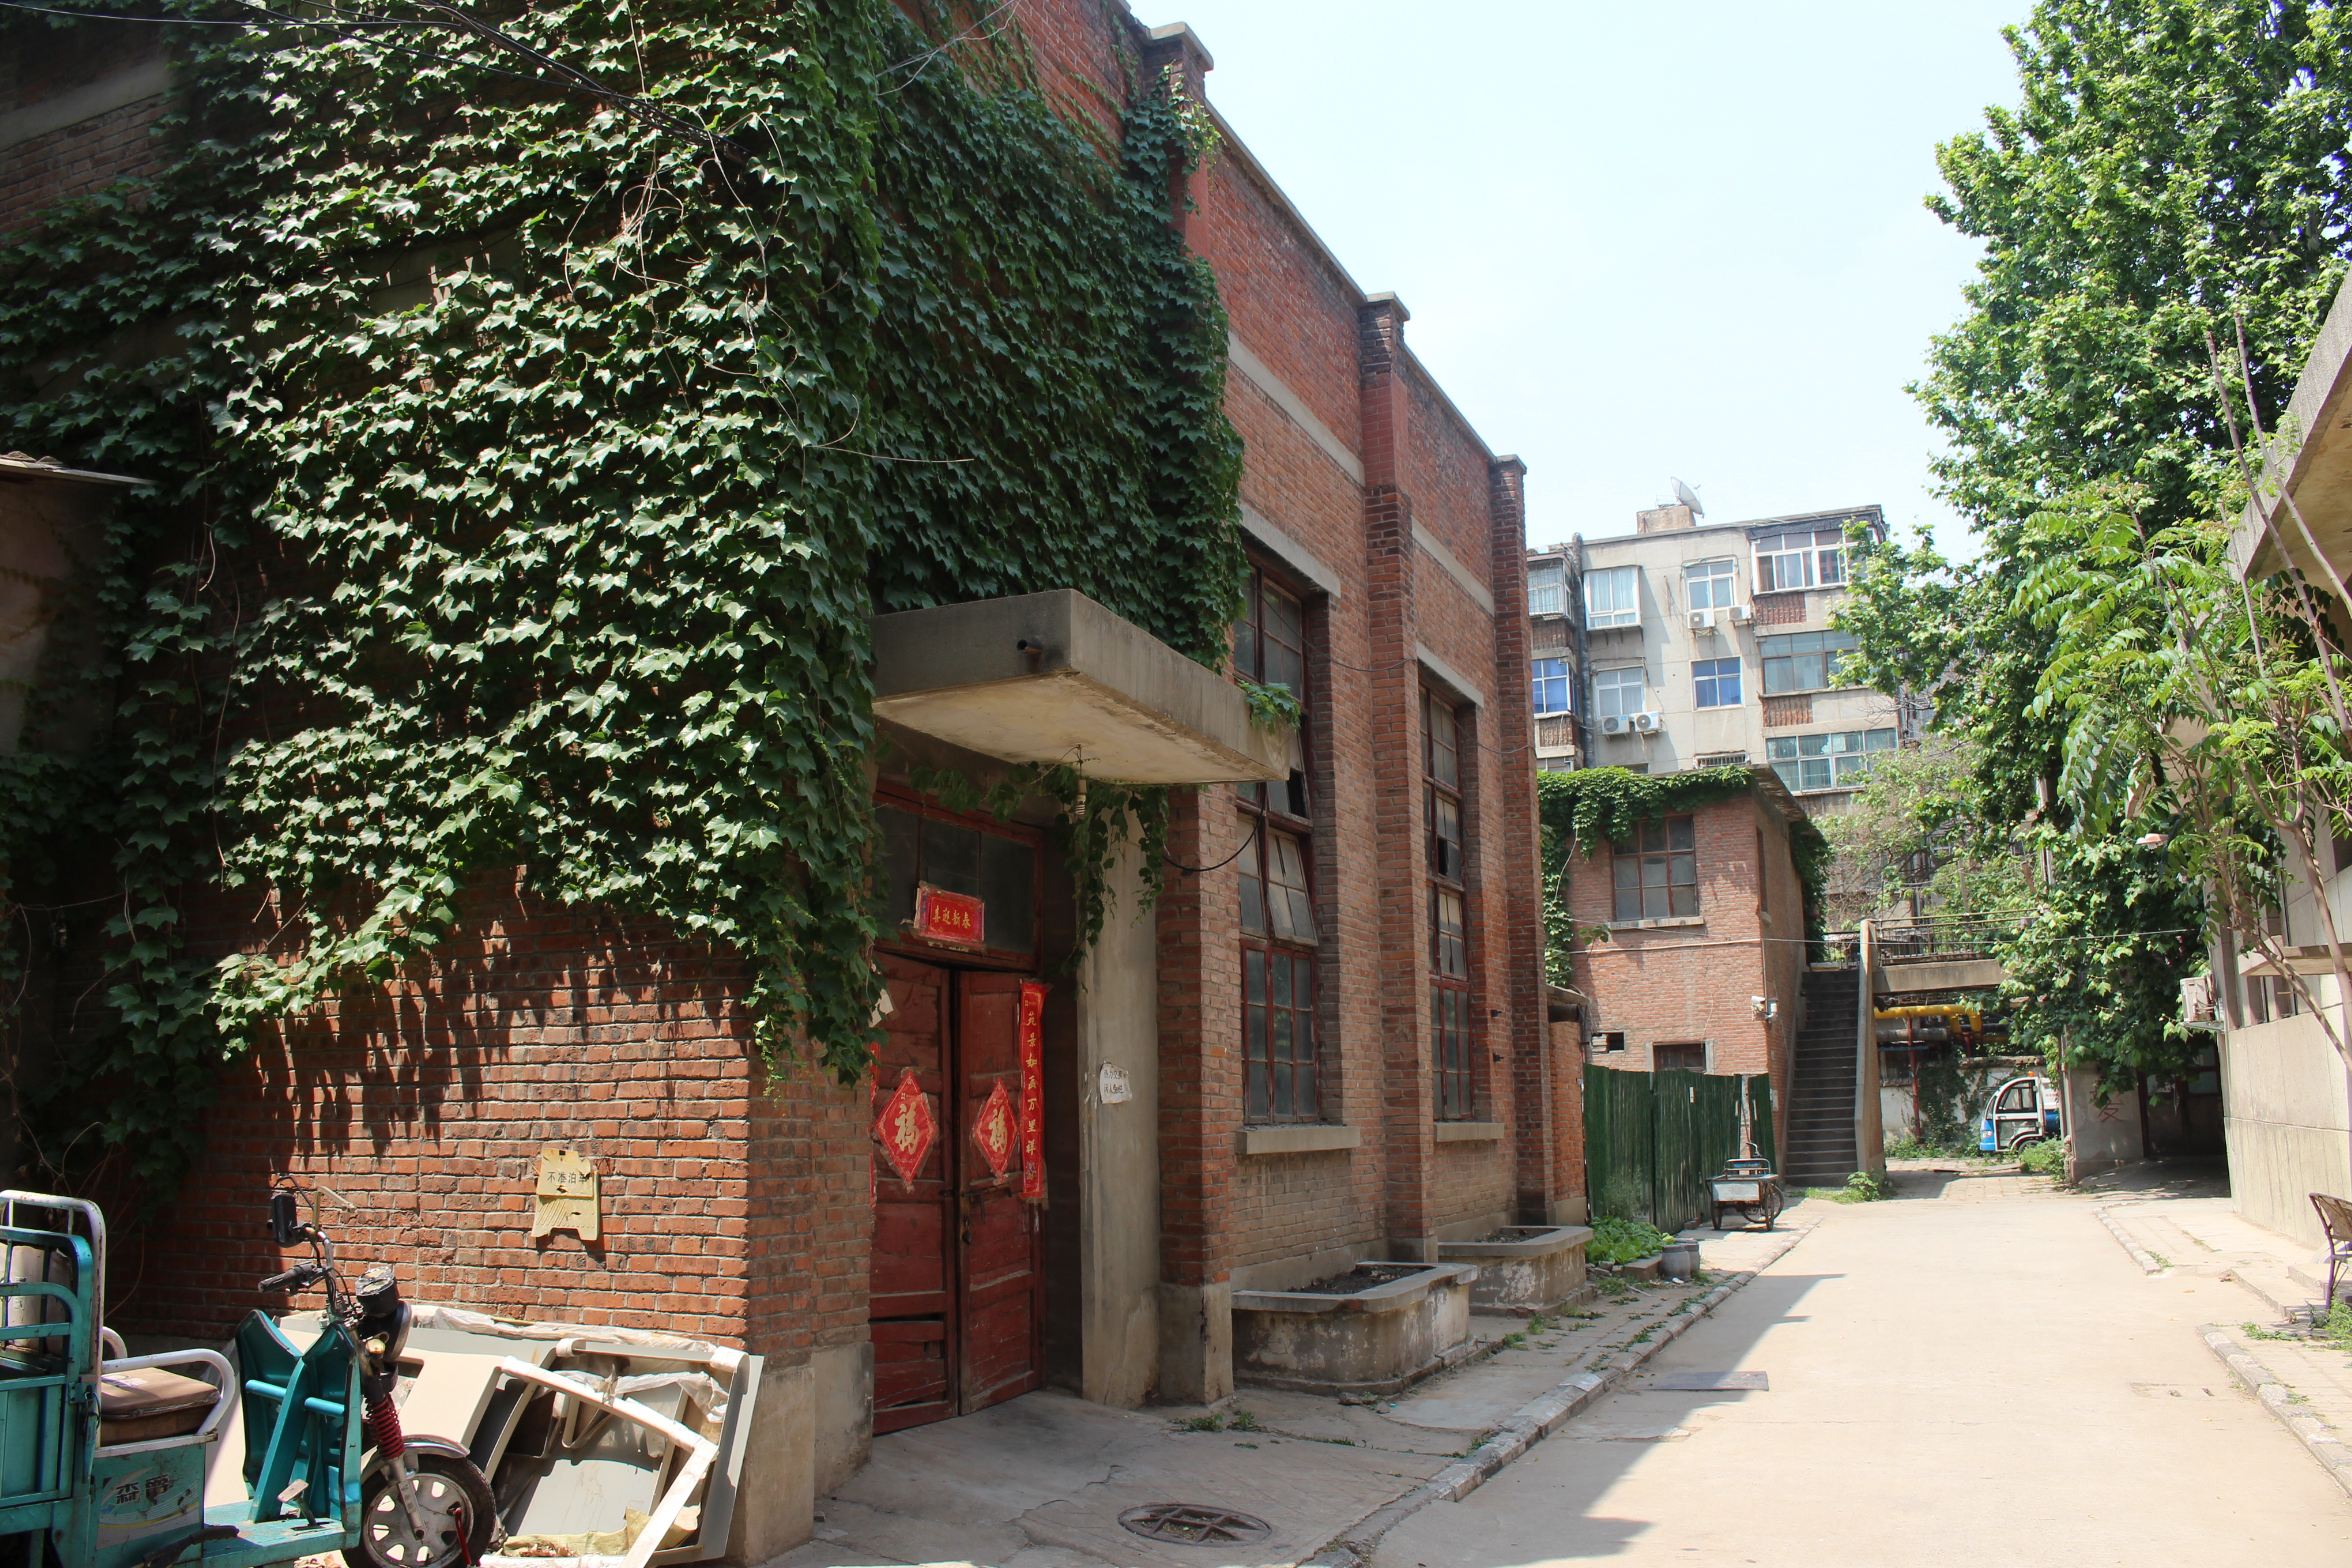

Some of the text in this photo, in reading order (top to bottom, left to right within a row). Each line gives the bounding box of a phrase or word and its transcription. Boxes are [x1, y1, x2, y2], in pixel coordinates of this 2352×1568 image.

[932, 904, 971, 930] 喜迎新春
[1026, 1011, 1038, 1156] 苑景如画万里祥
[894, 1101, 920, 1156] 福
[988, 1105, 1008, 1155] 福
[547, 1171, 588, 1186] 不准泊车
